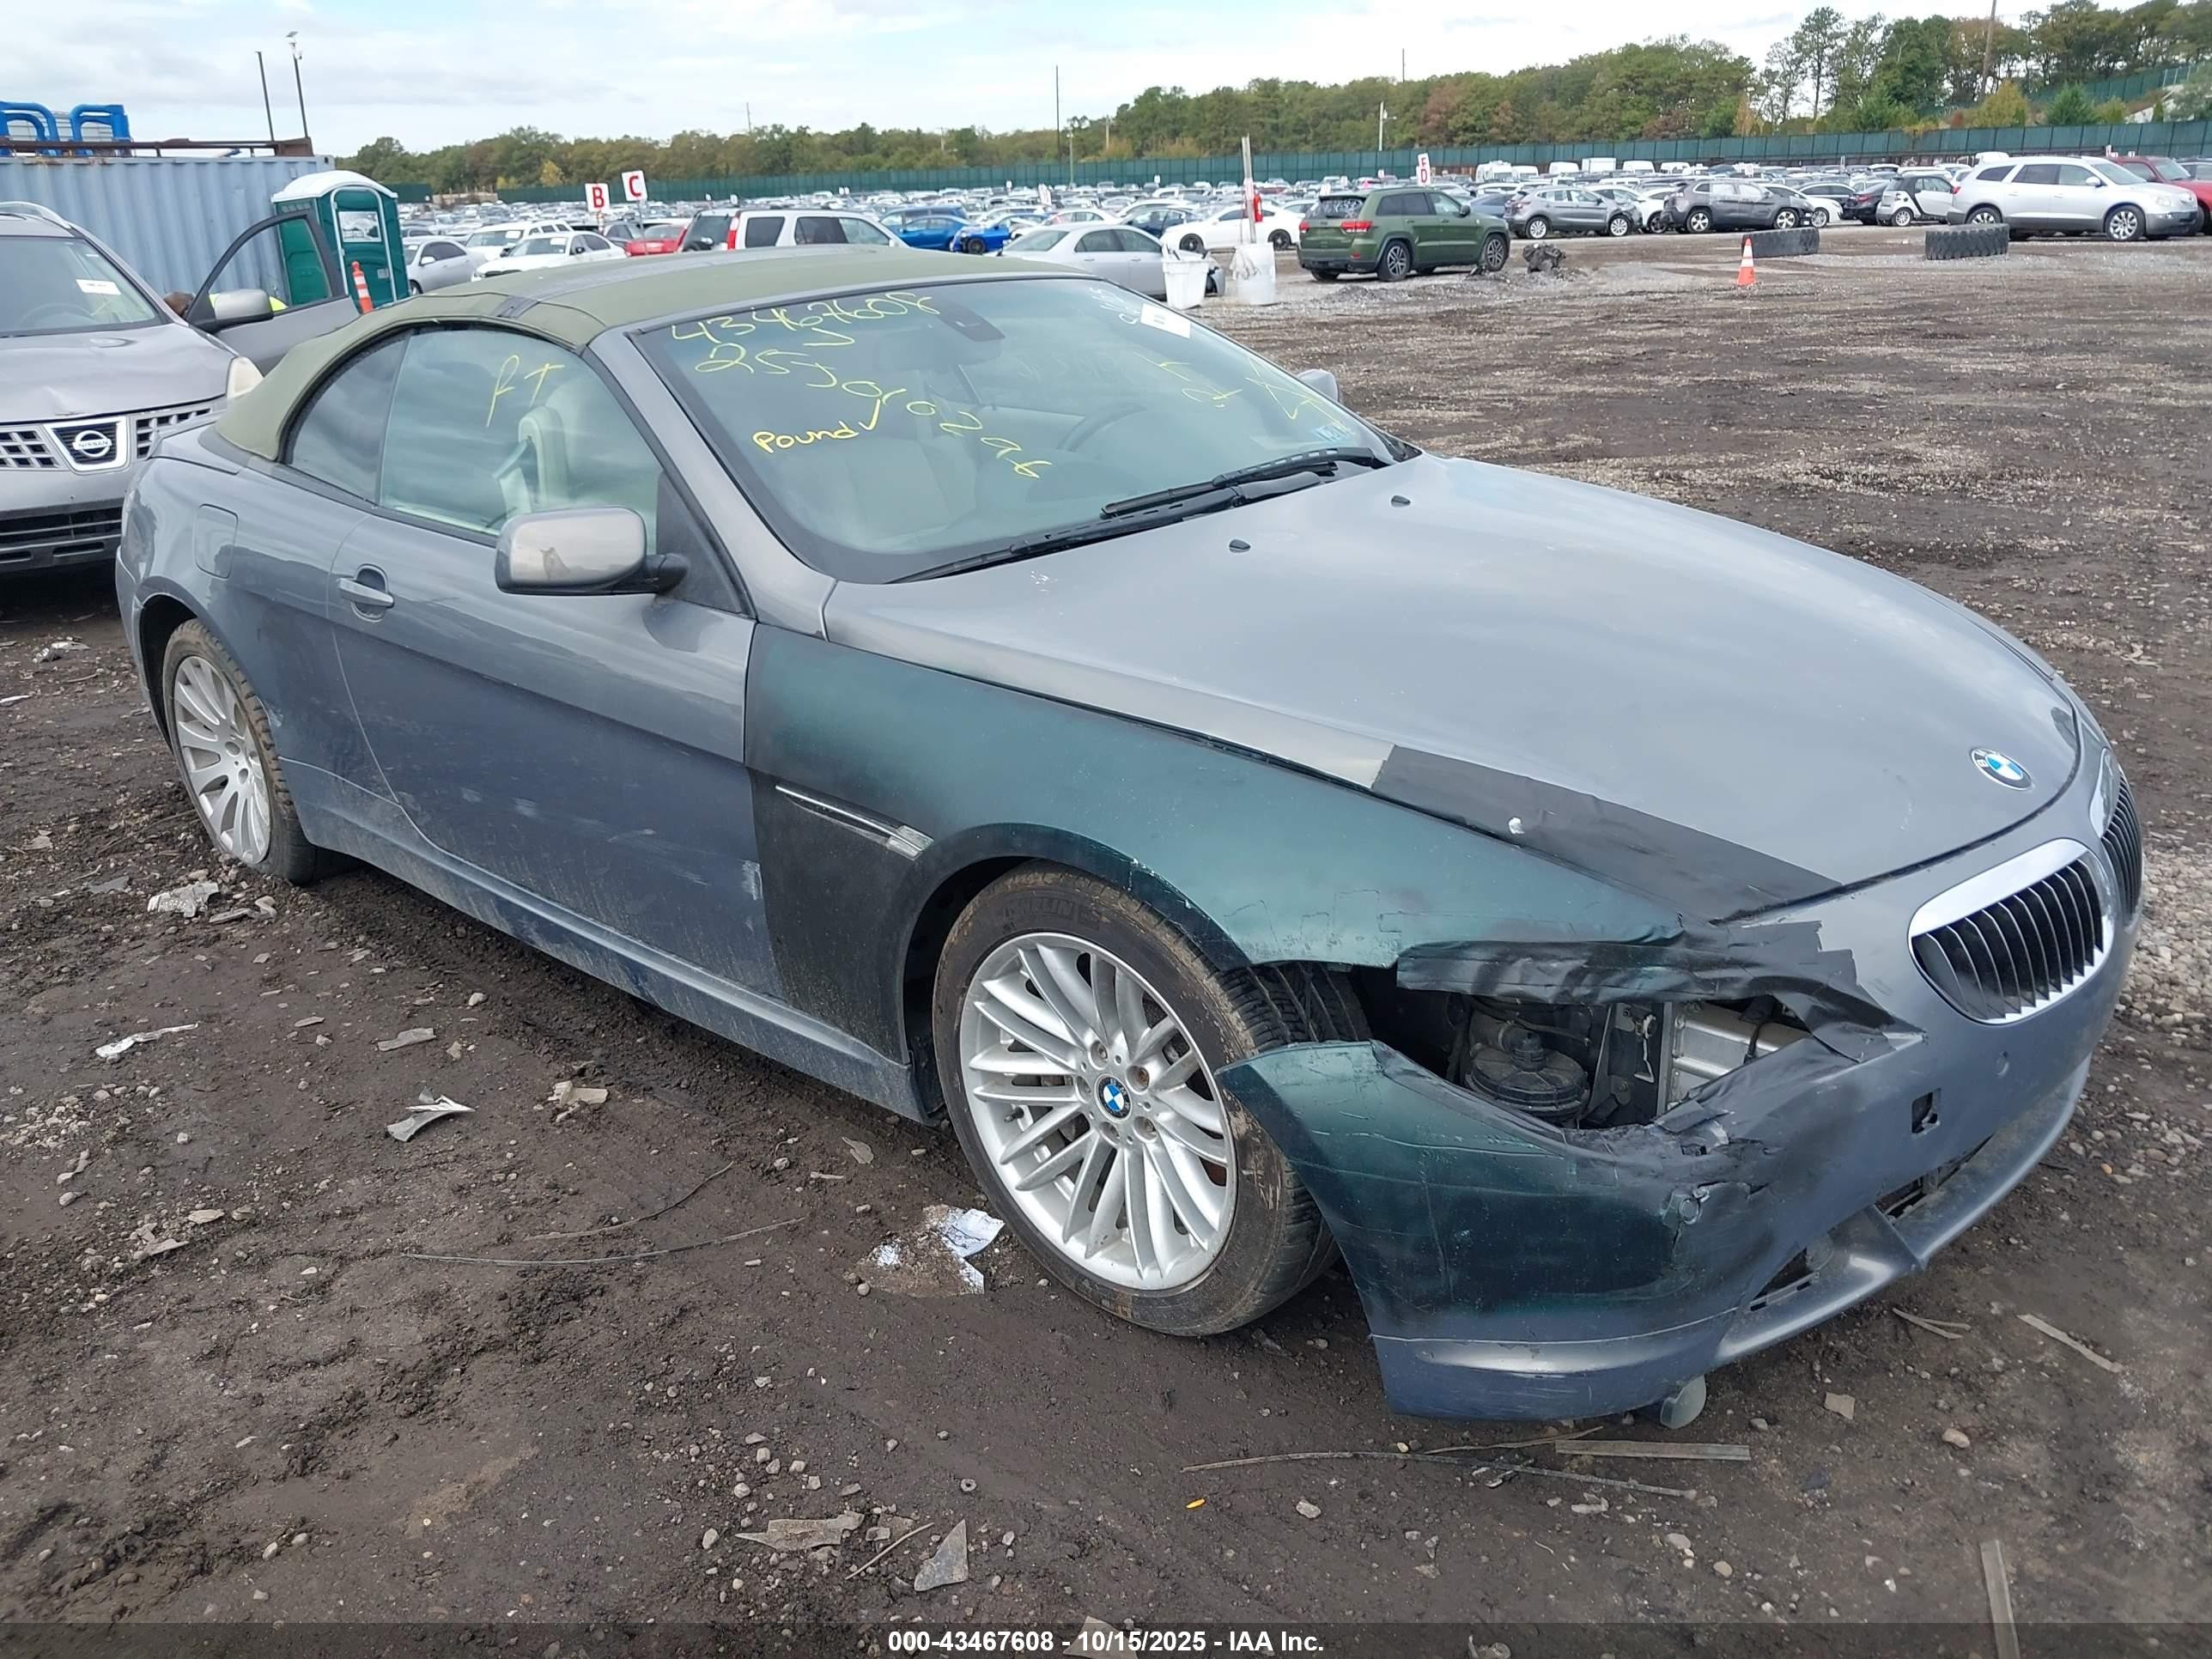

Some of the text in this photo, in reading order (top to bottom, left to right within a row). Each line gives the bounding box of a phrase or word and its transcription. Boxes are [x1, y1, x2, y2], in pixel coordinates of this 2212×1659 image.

[629, 175, 642, 198] C
[1420, 168, 1427, 183] D
[592, 186, 605, 209] B
